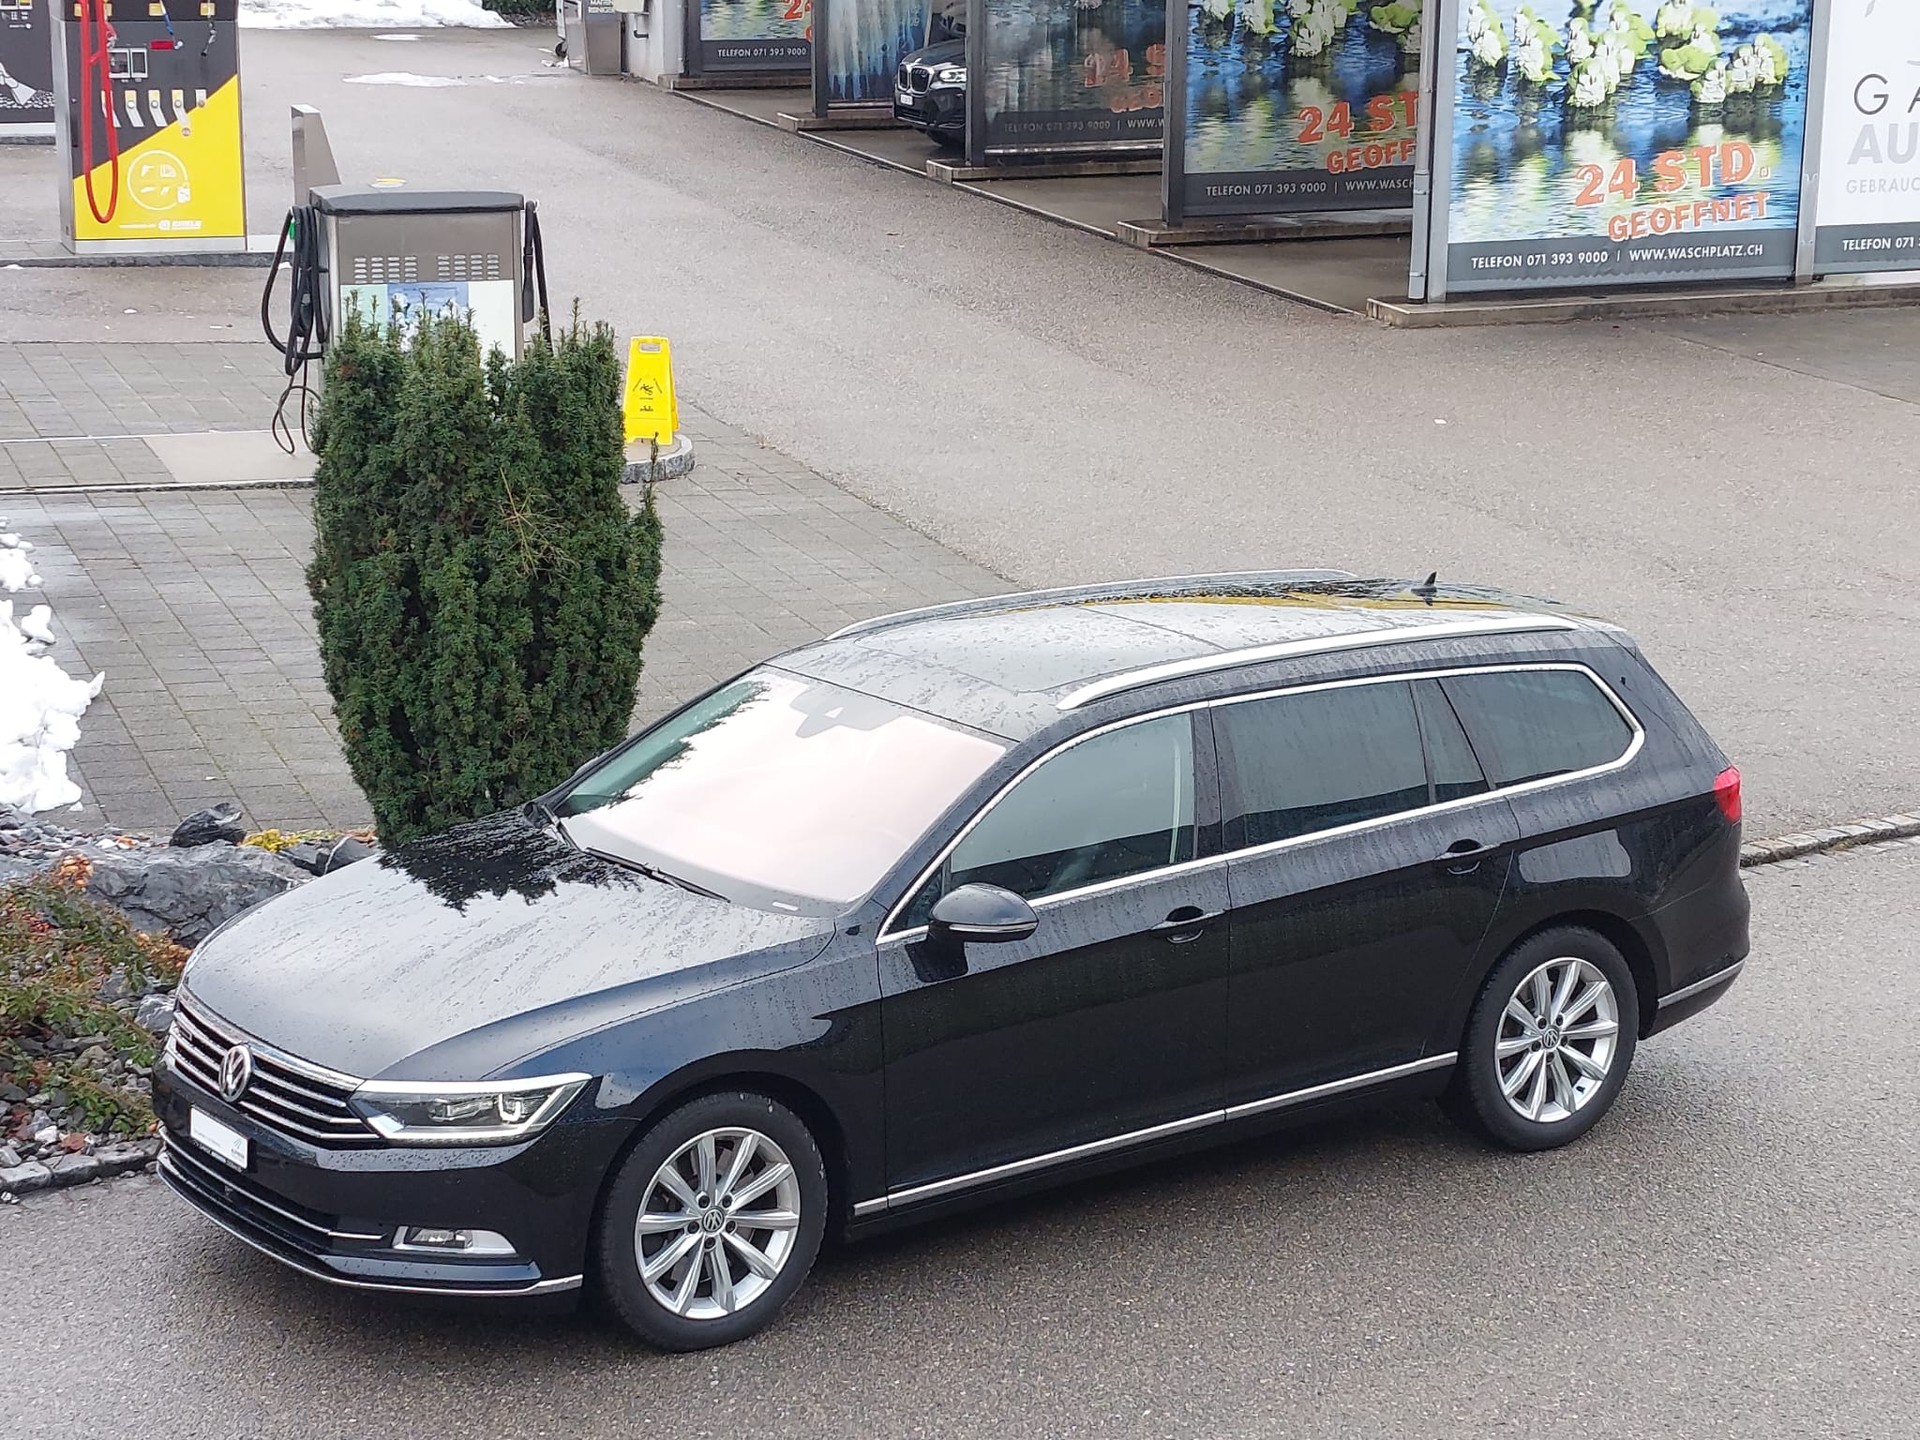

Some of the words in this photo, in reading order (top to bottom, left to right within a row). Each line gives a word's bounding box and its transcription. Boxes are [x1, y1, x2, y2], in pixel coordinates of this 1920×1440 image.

[717, 48, 751, 57] TELEFON
[753, 48, 767, 56] 071
[769, 48, 784, 56] 393
[787, 47, 806, 56] 9000
[1297, 99, 1354, 144] 24
[1574, 157, 1640, 207] 24
[1653, 141, 1770, 193] STD.
[1206, 185, 1251, 197] TELEFON
[1254, 184, 1273, 195] 071
[1276, 183, 1297, 194] 393
[1300, 181, 1327, 193] 9000
[1607, 191, 1770, 242] GEÖFFNET
[1842, 237, 1892, 251] TELEFON
[1895, 236, 1914, 249] 071
[1471, 254, 1522, 269] TELEFON
[1526, 253, 1547, 266] 071
[1550, 252, 1573, 265] 393
[1577, 251, 1609, 264] 9000
[1629, 244, 1764, 262] WWW.WASCHPLATZ.CH
